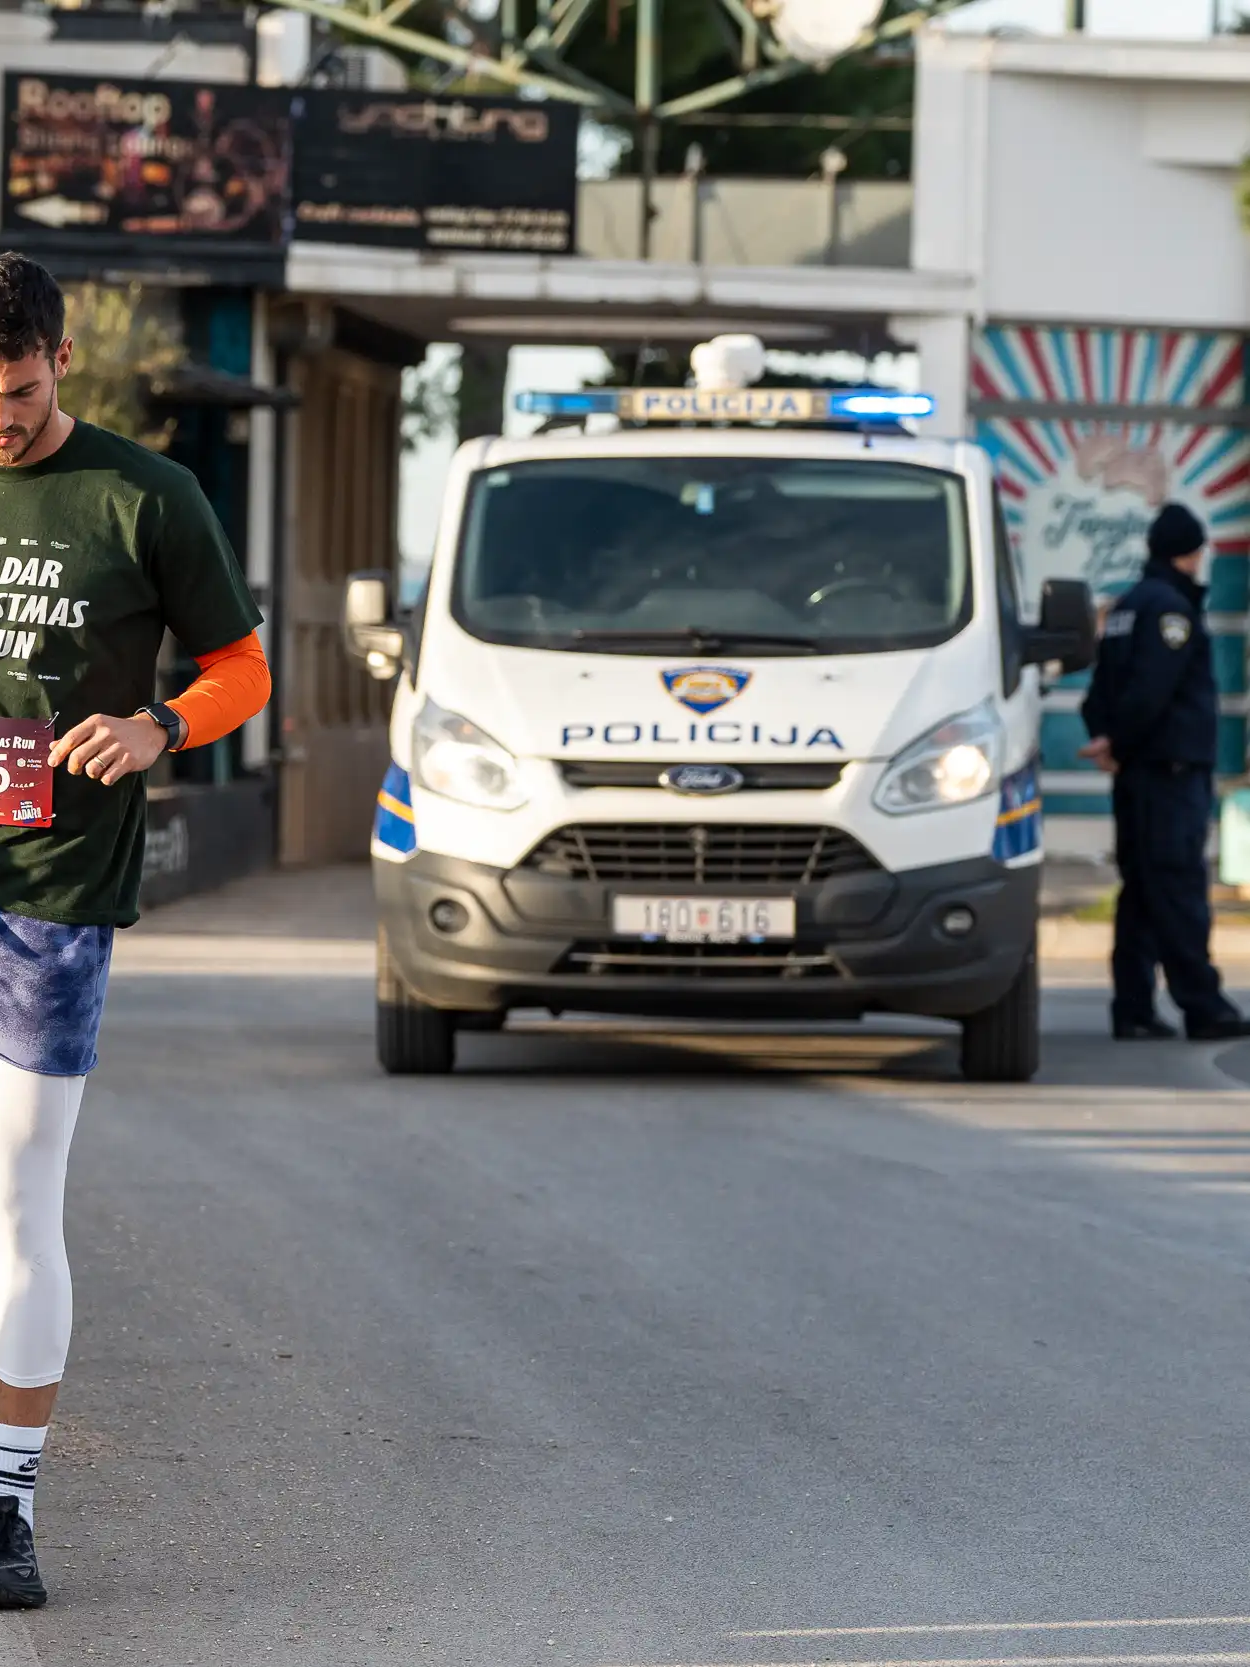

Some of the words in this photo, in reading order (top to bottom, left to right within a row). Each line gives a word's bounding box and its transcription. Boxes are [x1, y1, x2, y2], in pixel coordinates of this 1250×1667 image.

[645, 392, 799, 416] POLICIJA
[561, 722, 845, 750] POLICIJA
[718, 900, 770, 934] 616
